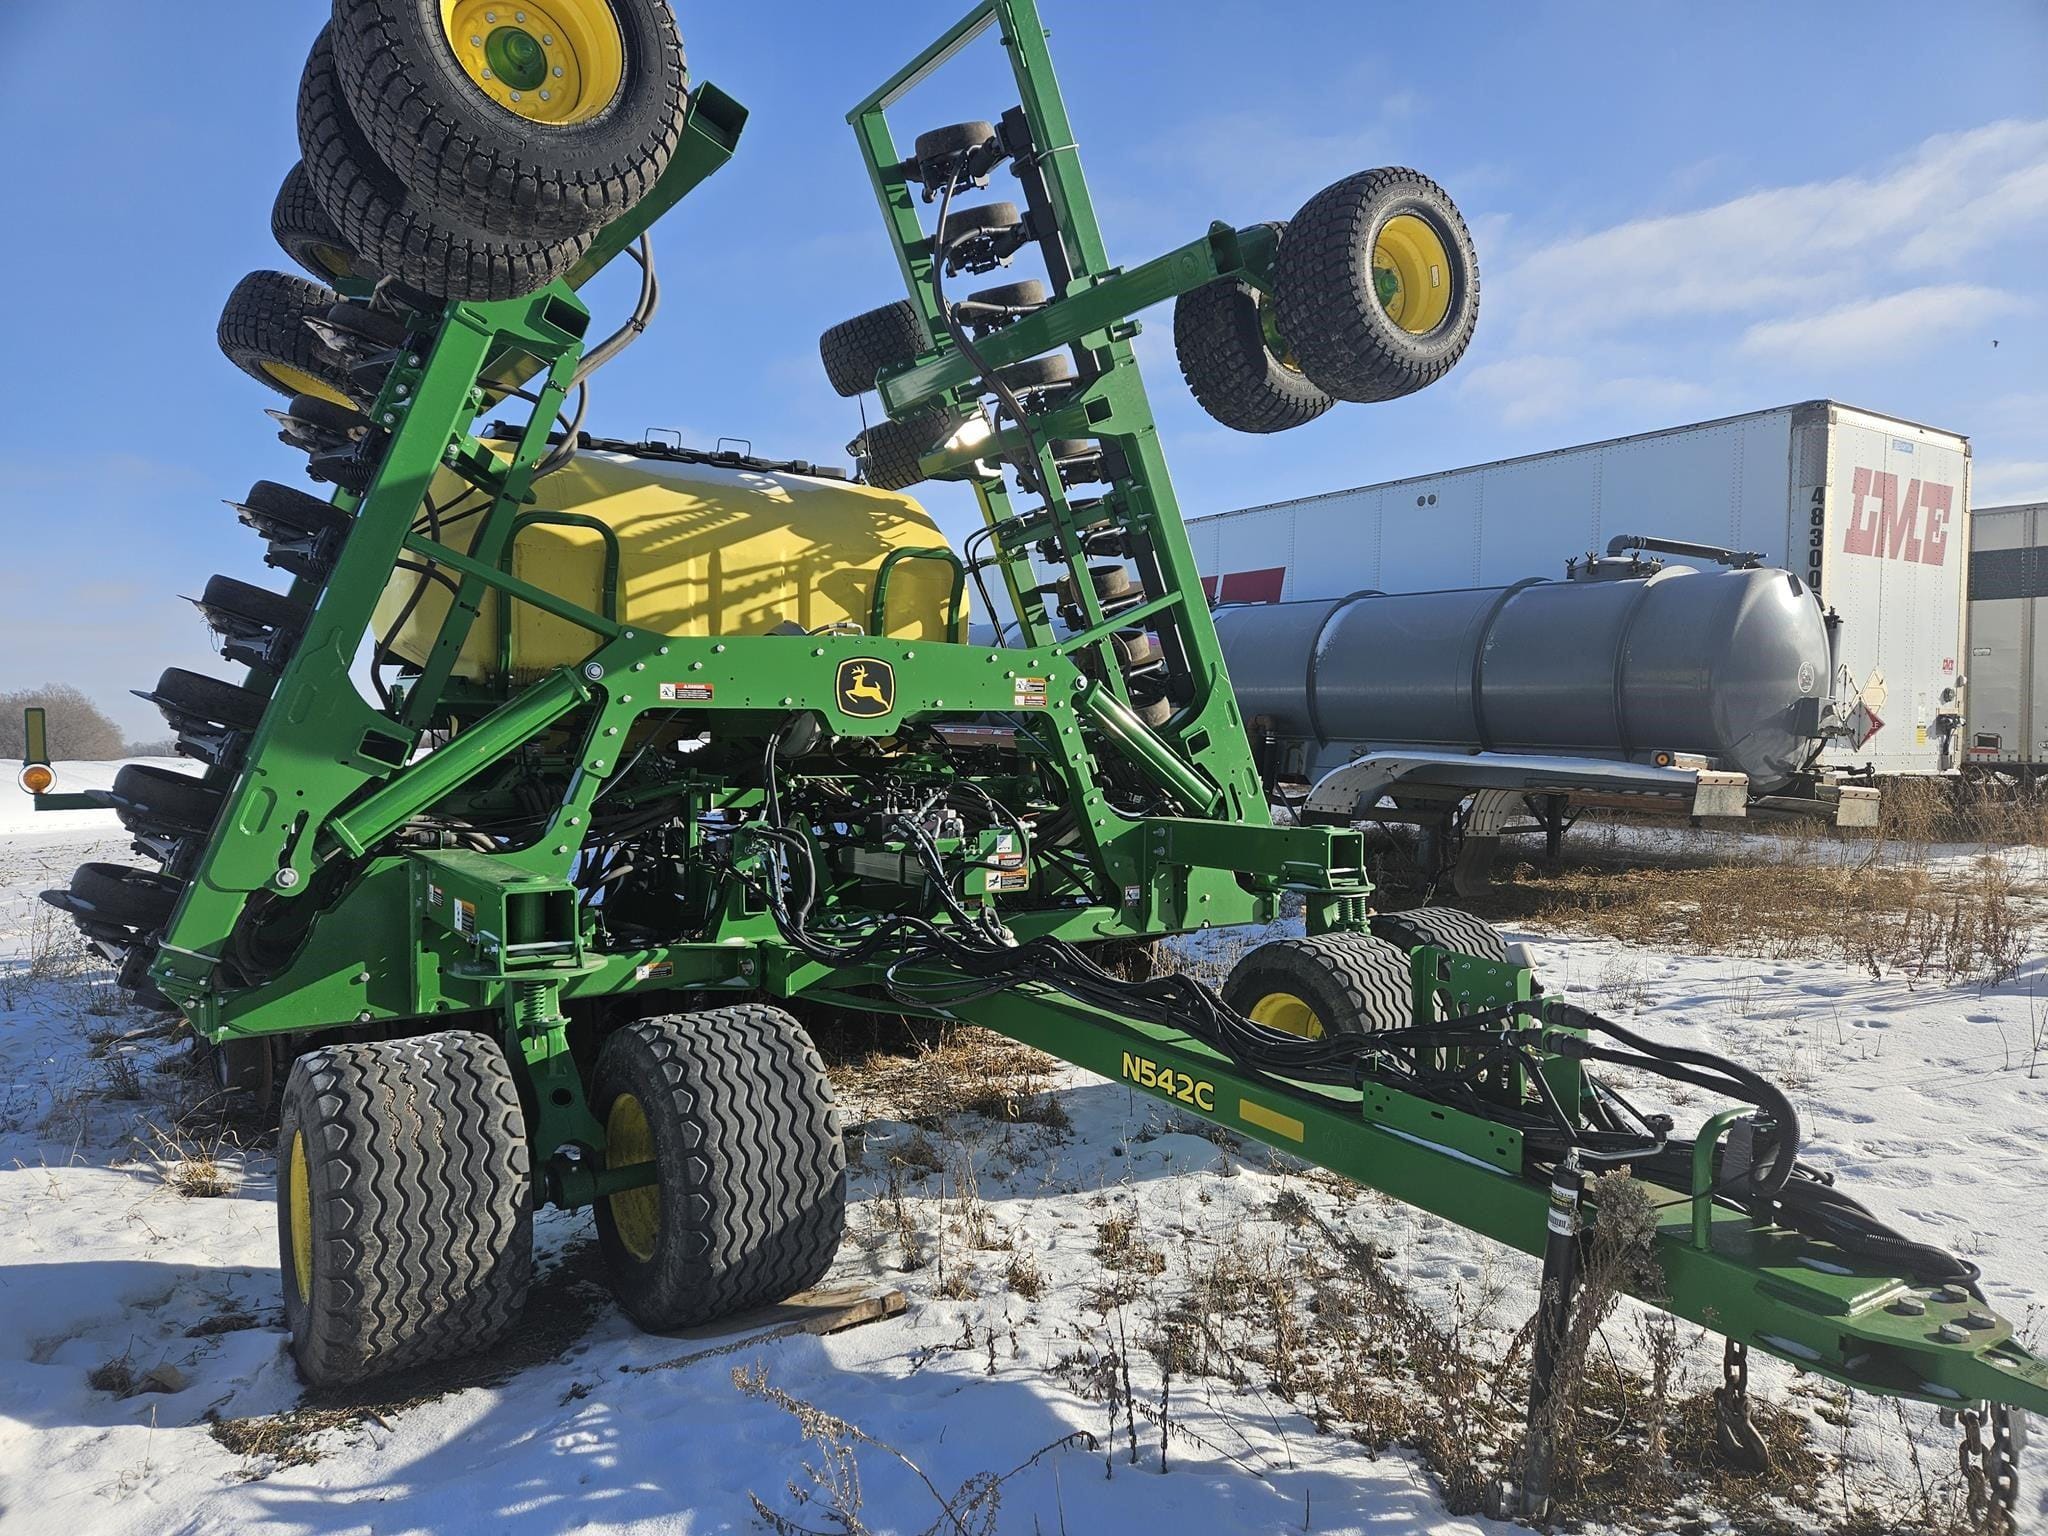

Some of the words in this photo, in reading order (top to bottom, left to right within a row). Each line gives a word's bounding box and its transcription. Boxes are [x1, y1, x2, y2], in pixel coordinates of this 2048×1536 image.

[1808, 486, 1825, 597] 48300
[1843, 466, 1954, 567] LME
[1122, 1050, 1215, 1112] N542C
